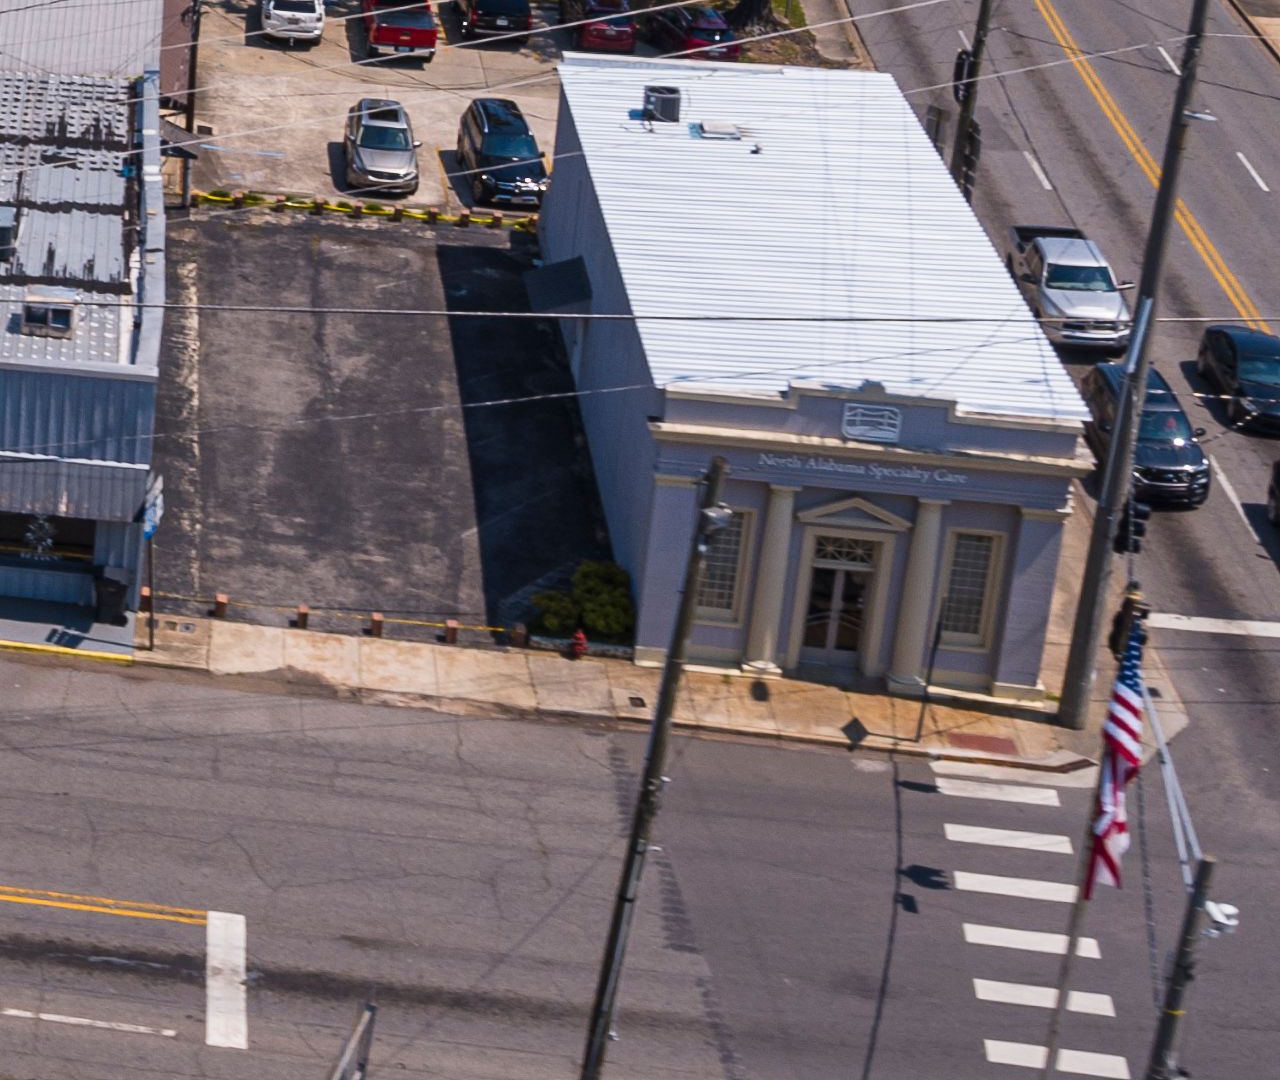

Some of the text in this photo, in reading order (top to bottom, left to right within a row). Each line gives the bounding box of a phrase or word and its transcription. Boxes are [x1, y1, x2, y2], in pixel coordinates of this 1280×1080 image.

[758, 453, 969, 484] North Alabama Specialty Care
